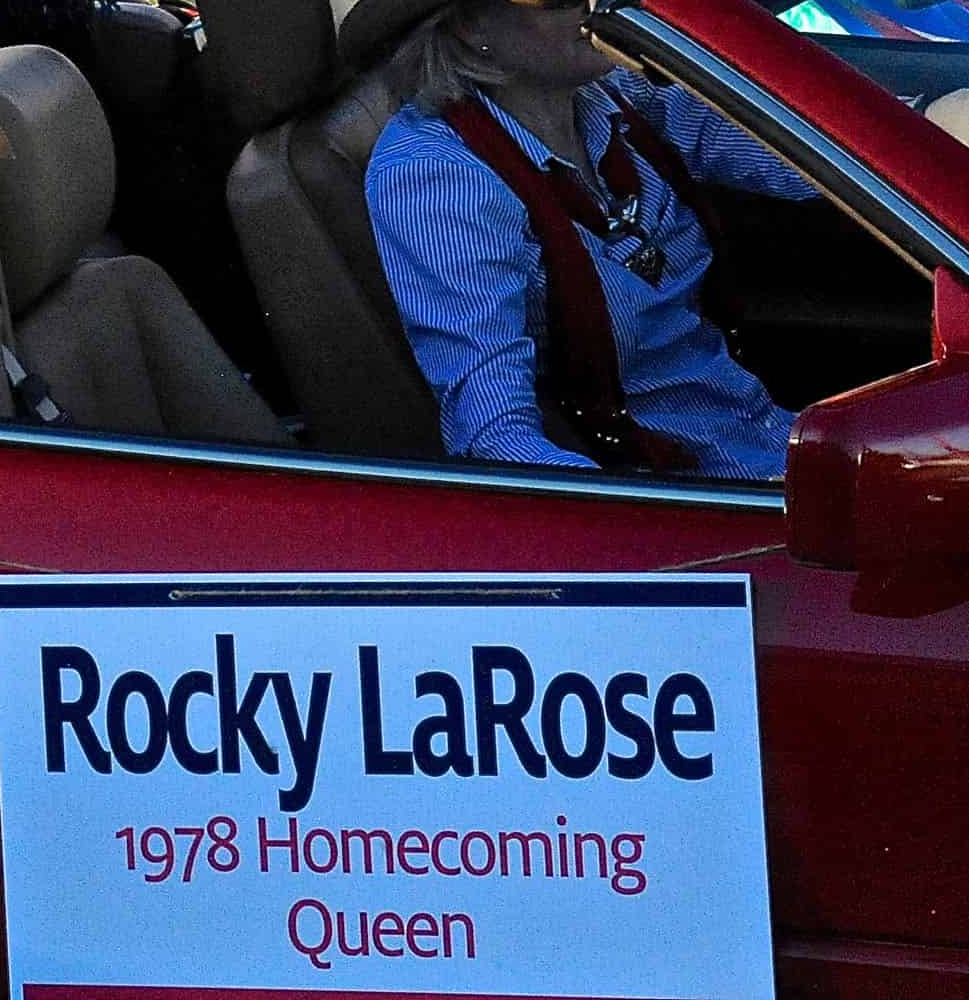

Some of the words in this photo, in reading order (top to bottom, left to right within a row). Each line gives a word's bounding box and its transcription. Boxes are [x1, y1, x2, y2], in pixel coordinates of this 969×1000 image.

[40, 634, 332, 811] Rocky
[358, 645, 715, 780] LaRose
[115, 817, 239, 882] 1978
[258, 815, 647, 896] Homecoming
[288, 899, 476, 969] Queen
